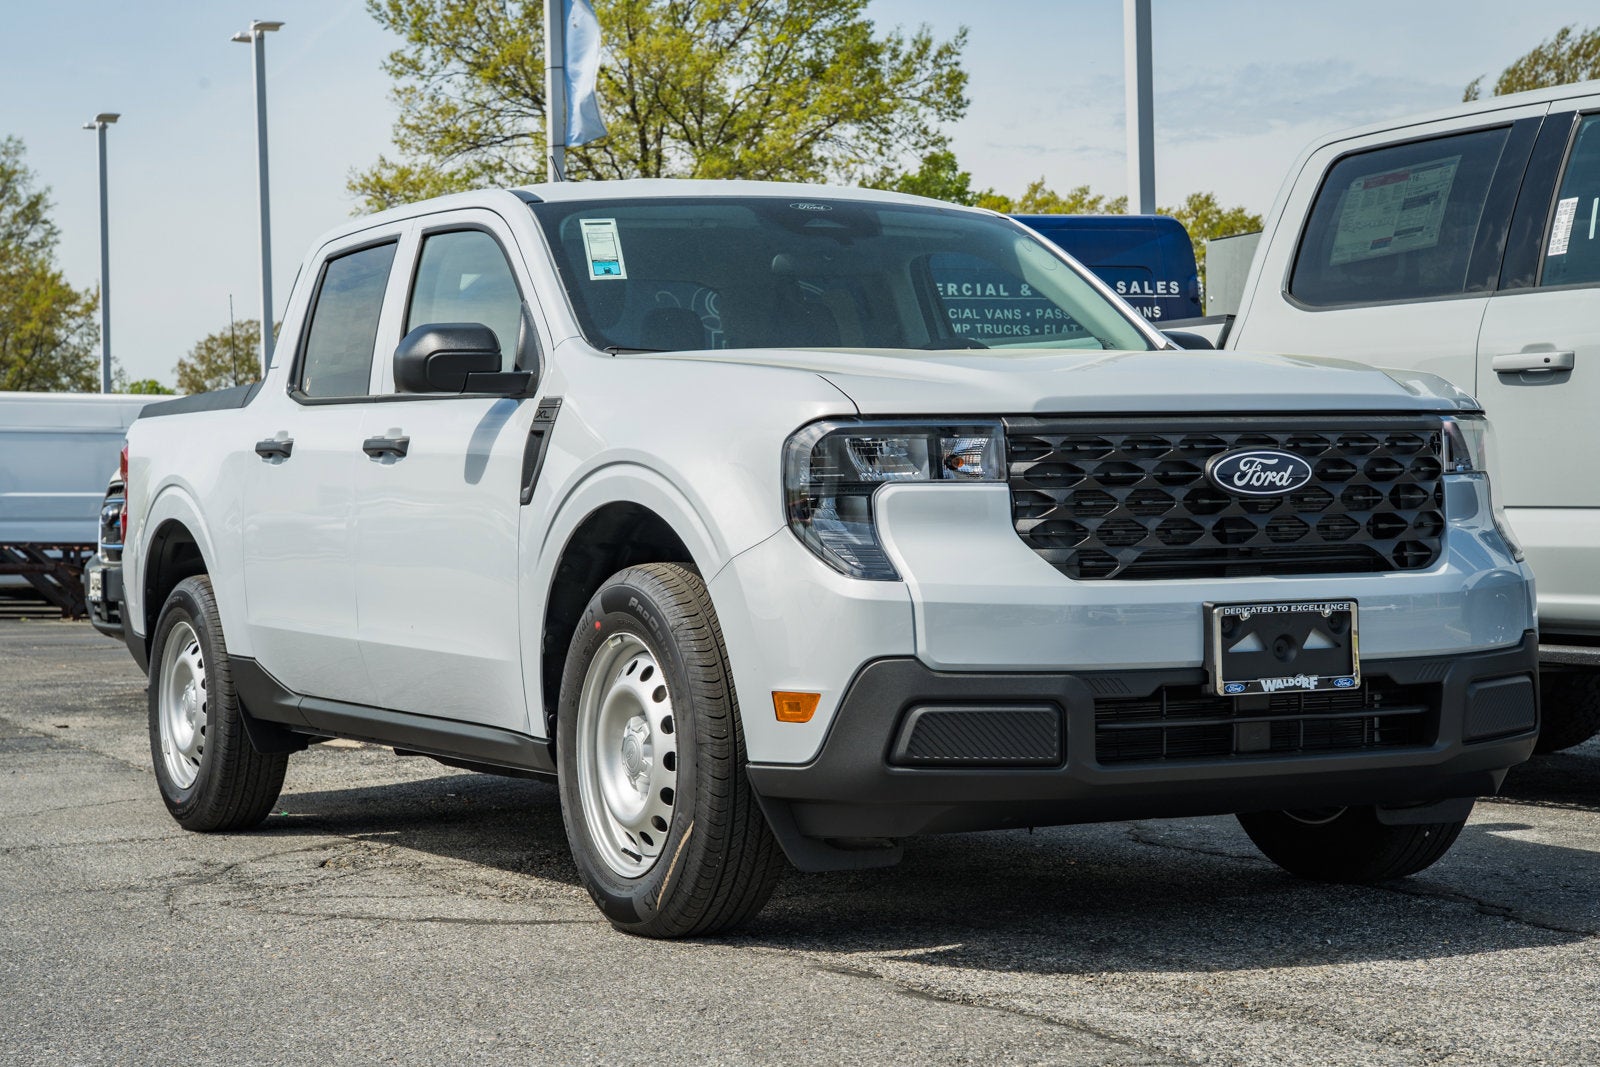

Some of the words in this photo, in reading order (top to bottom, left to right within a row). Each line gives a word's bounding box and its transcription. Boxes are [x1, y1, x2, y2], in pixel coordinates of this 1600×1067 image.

[1020, 284, 1032, 296] &
[1116, 281, 1180, 294] SALES
[948, 308, 980, 319] CIAL
[984, 308, 1021, 320] VANS
[975, 323, 1031, 335] TRUCKS
[536, 410, 550, 419] XL
[1233, 457, 1294, 487] Ford
[1224, 606, 1274, 615] DEDICATED
[1290, 603, 1350, 612] EXCELLENCE
[1260, 675, 1318, 692] WALDORF
